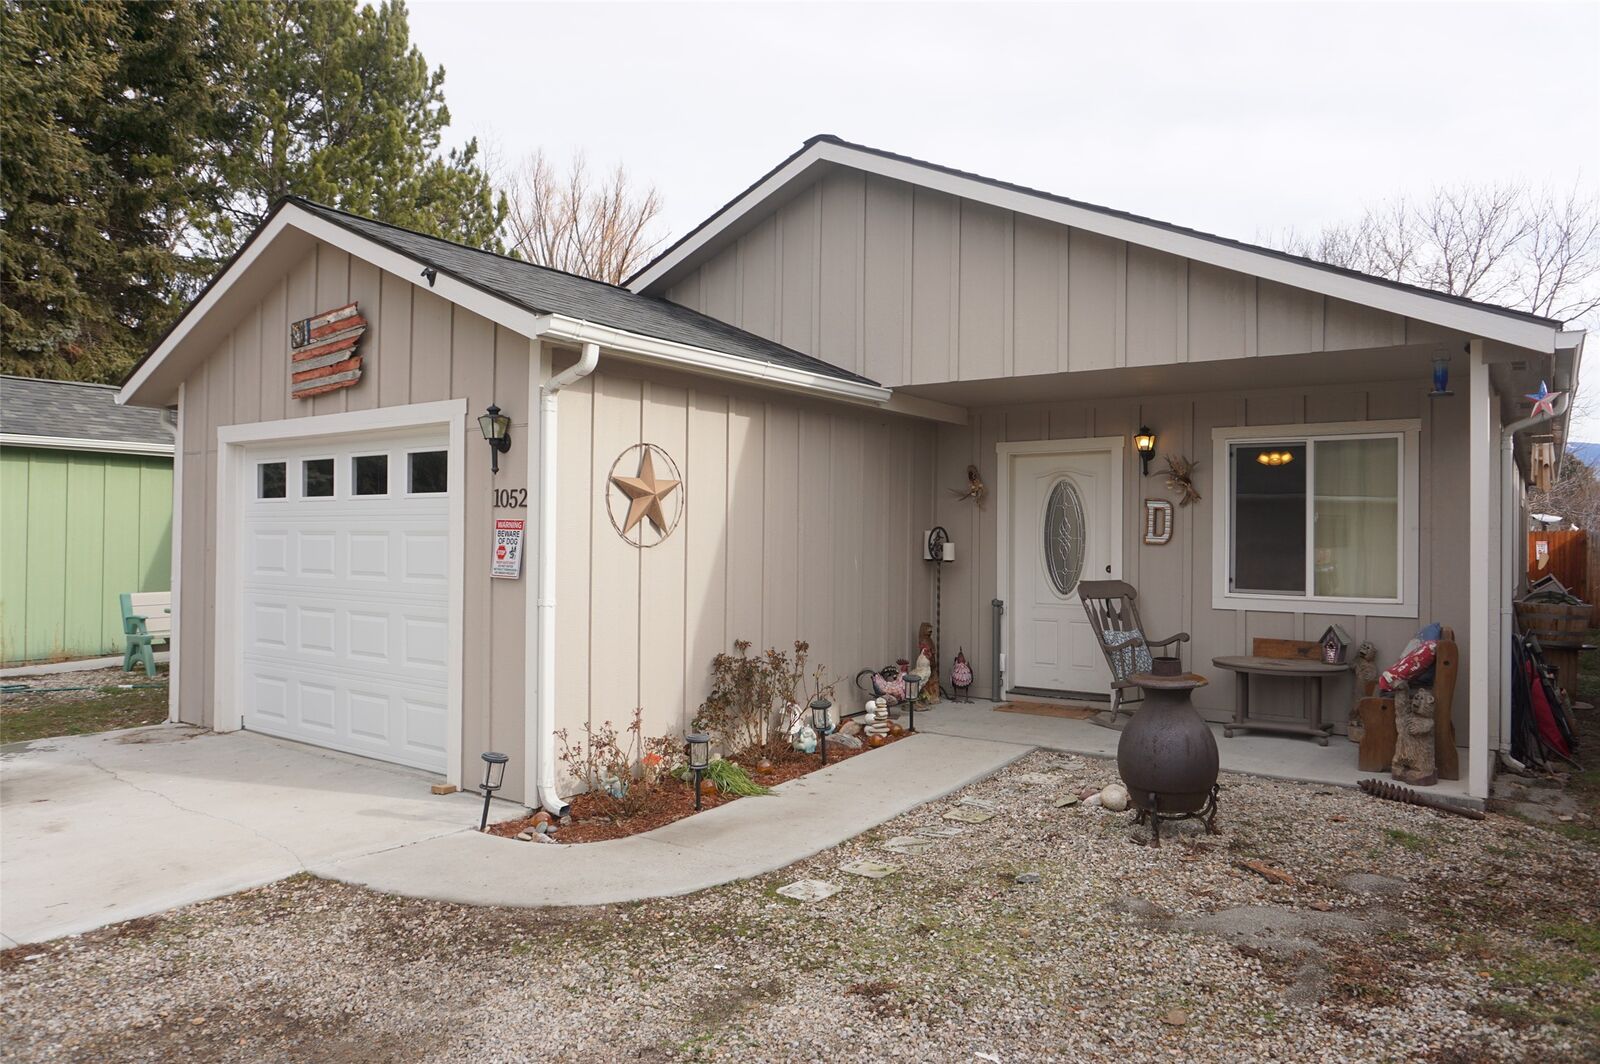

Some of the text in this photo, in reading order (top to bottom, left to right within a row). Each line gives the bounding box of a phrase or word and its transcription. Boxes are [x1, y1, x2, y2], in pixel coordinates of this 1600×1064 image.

[494, 488, 527, 508] 1052
[497, 521, 522, 529] WARNING
[1144, 499, 1174, 545] D
